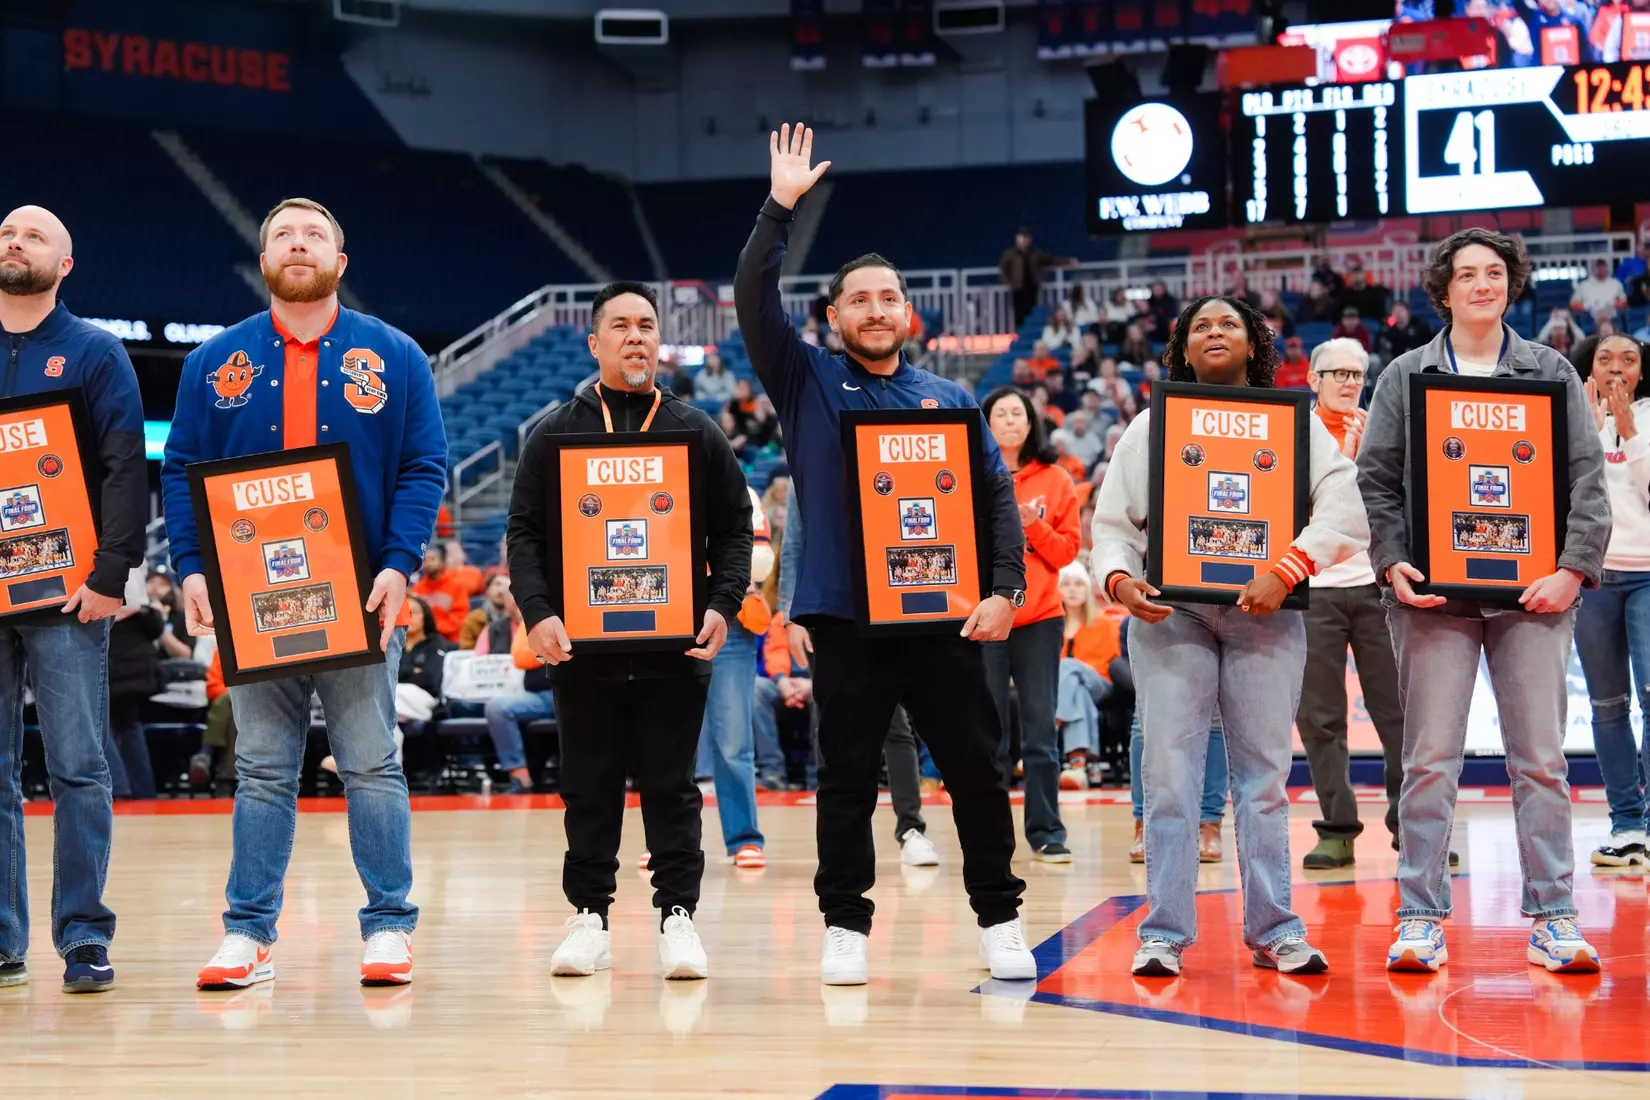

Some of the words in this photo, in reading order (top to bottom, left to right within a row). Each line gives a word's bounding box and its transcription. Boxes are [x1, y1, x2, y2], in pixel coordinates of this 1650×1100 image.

[63, 28, 290, 92] SYRACUSE
[1444, 109, 1495, 175] 41
[44, 356, 66, 377] S
[1195, 409, 1261, 438] 'CUSE
[1454, 402, 1519, 430] 'CUSE
[881, 435, 940, 461] 'CUSE
[590, 458, 656, 483] 'CUSE
[236, 474, 307, 507] 'CUSE
[4, 506, 21, 515] FINAL
[20, 504, 36, 513] FOUR
[271, 559, 287, 567] FINAL
